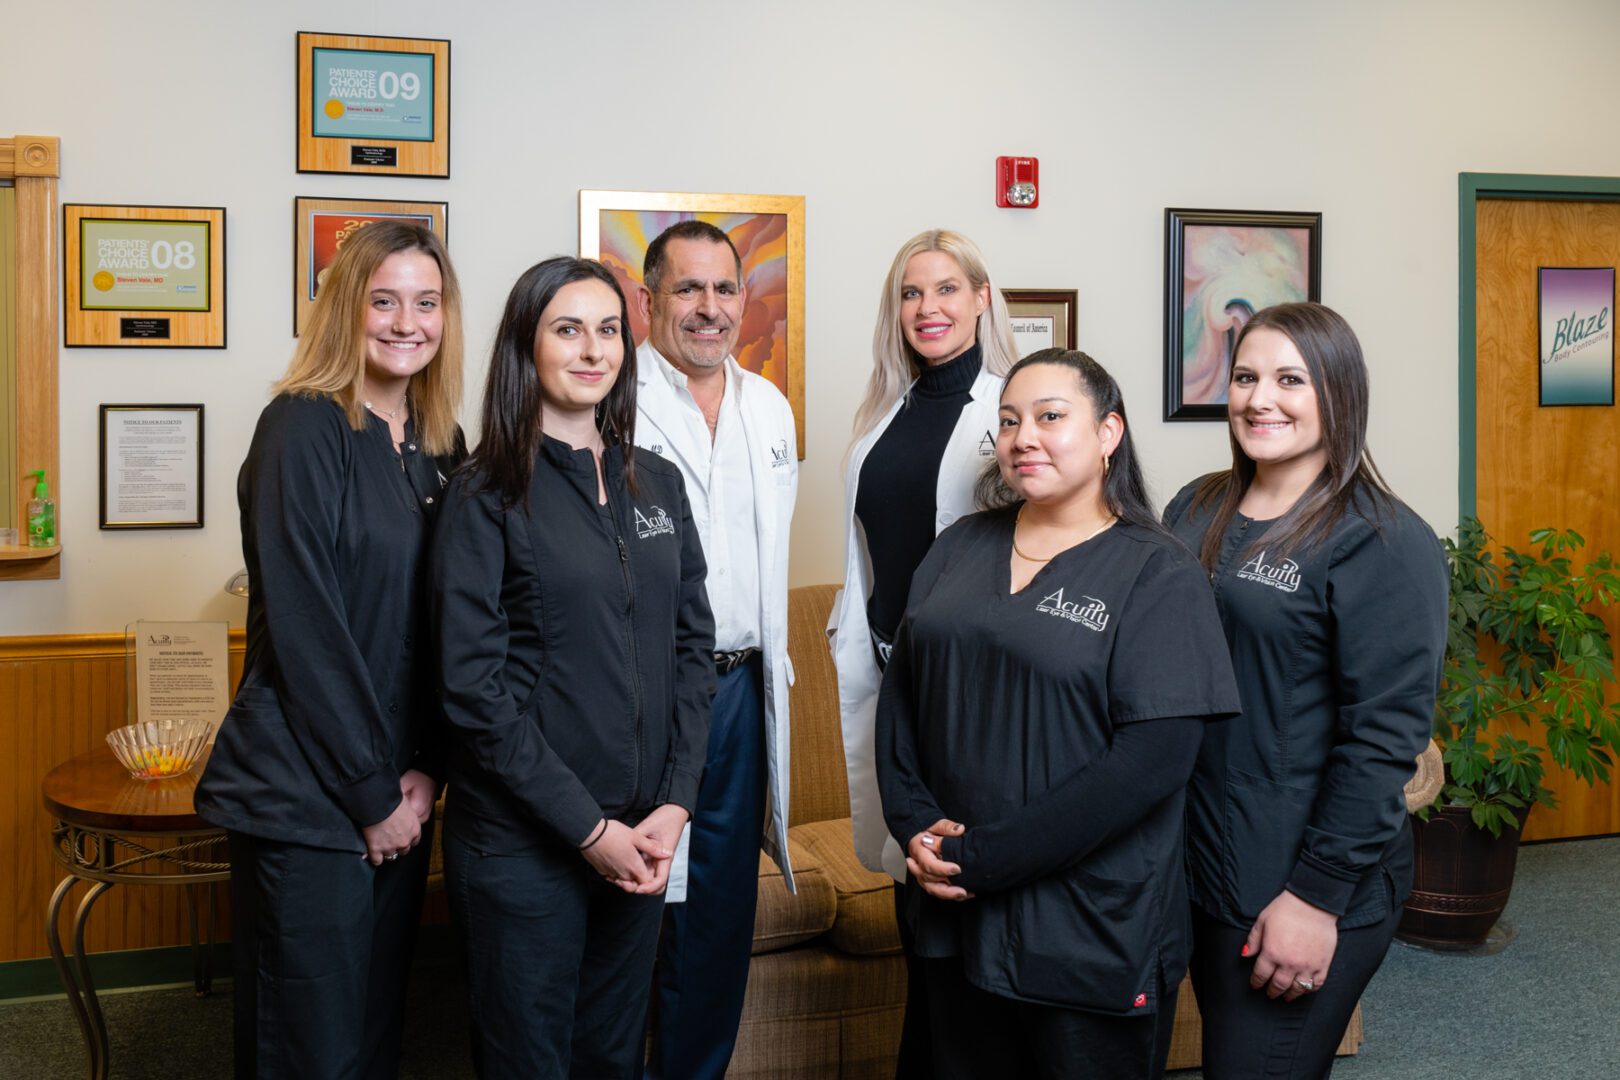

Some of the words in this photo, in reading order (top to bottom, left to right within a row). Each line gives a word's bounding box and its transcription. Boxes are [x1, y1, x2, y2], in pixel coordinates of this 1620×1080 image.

[329, 77, 376, 89] CHOICE
[329, 87, 377, 99] AWARD
[378, 71, 420, 100] 09
[98, 248, 148, 259] CHOICE
[98, 258, 149, 269] AWARD
[151, 239, 196, 270] 08
[1026, 322, 1031, 333] of
[1031, 323, 1048, 333] America
[1543, 307, 1608, 364] Blaze
[1554, 350, 1571, 362] Body
[634, 506, 675, 534] Acuity
[1241, 550, 1301, 592] Acuity
[1039, 587, 1110, 631] Acuity
